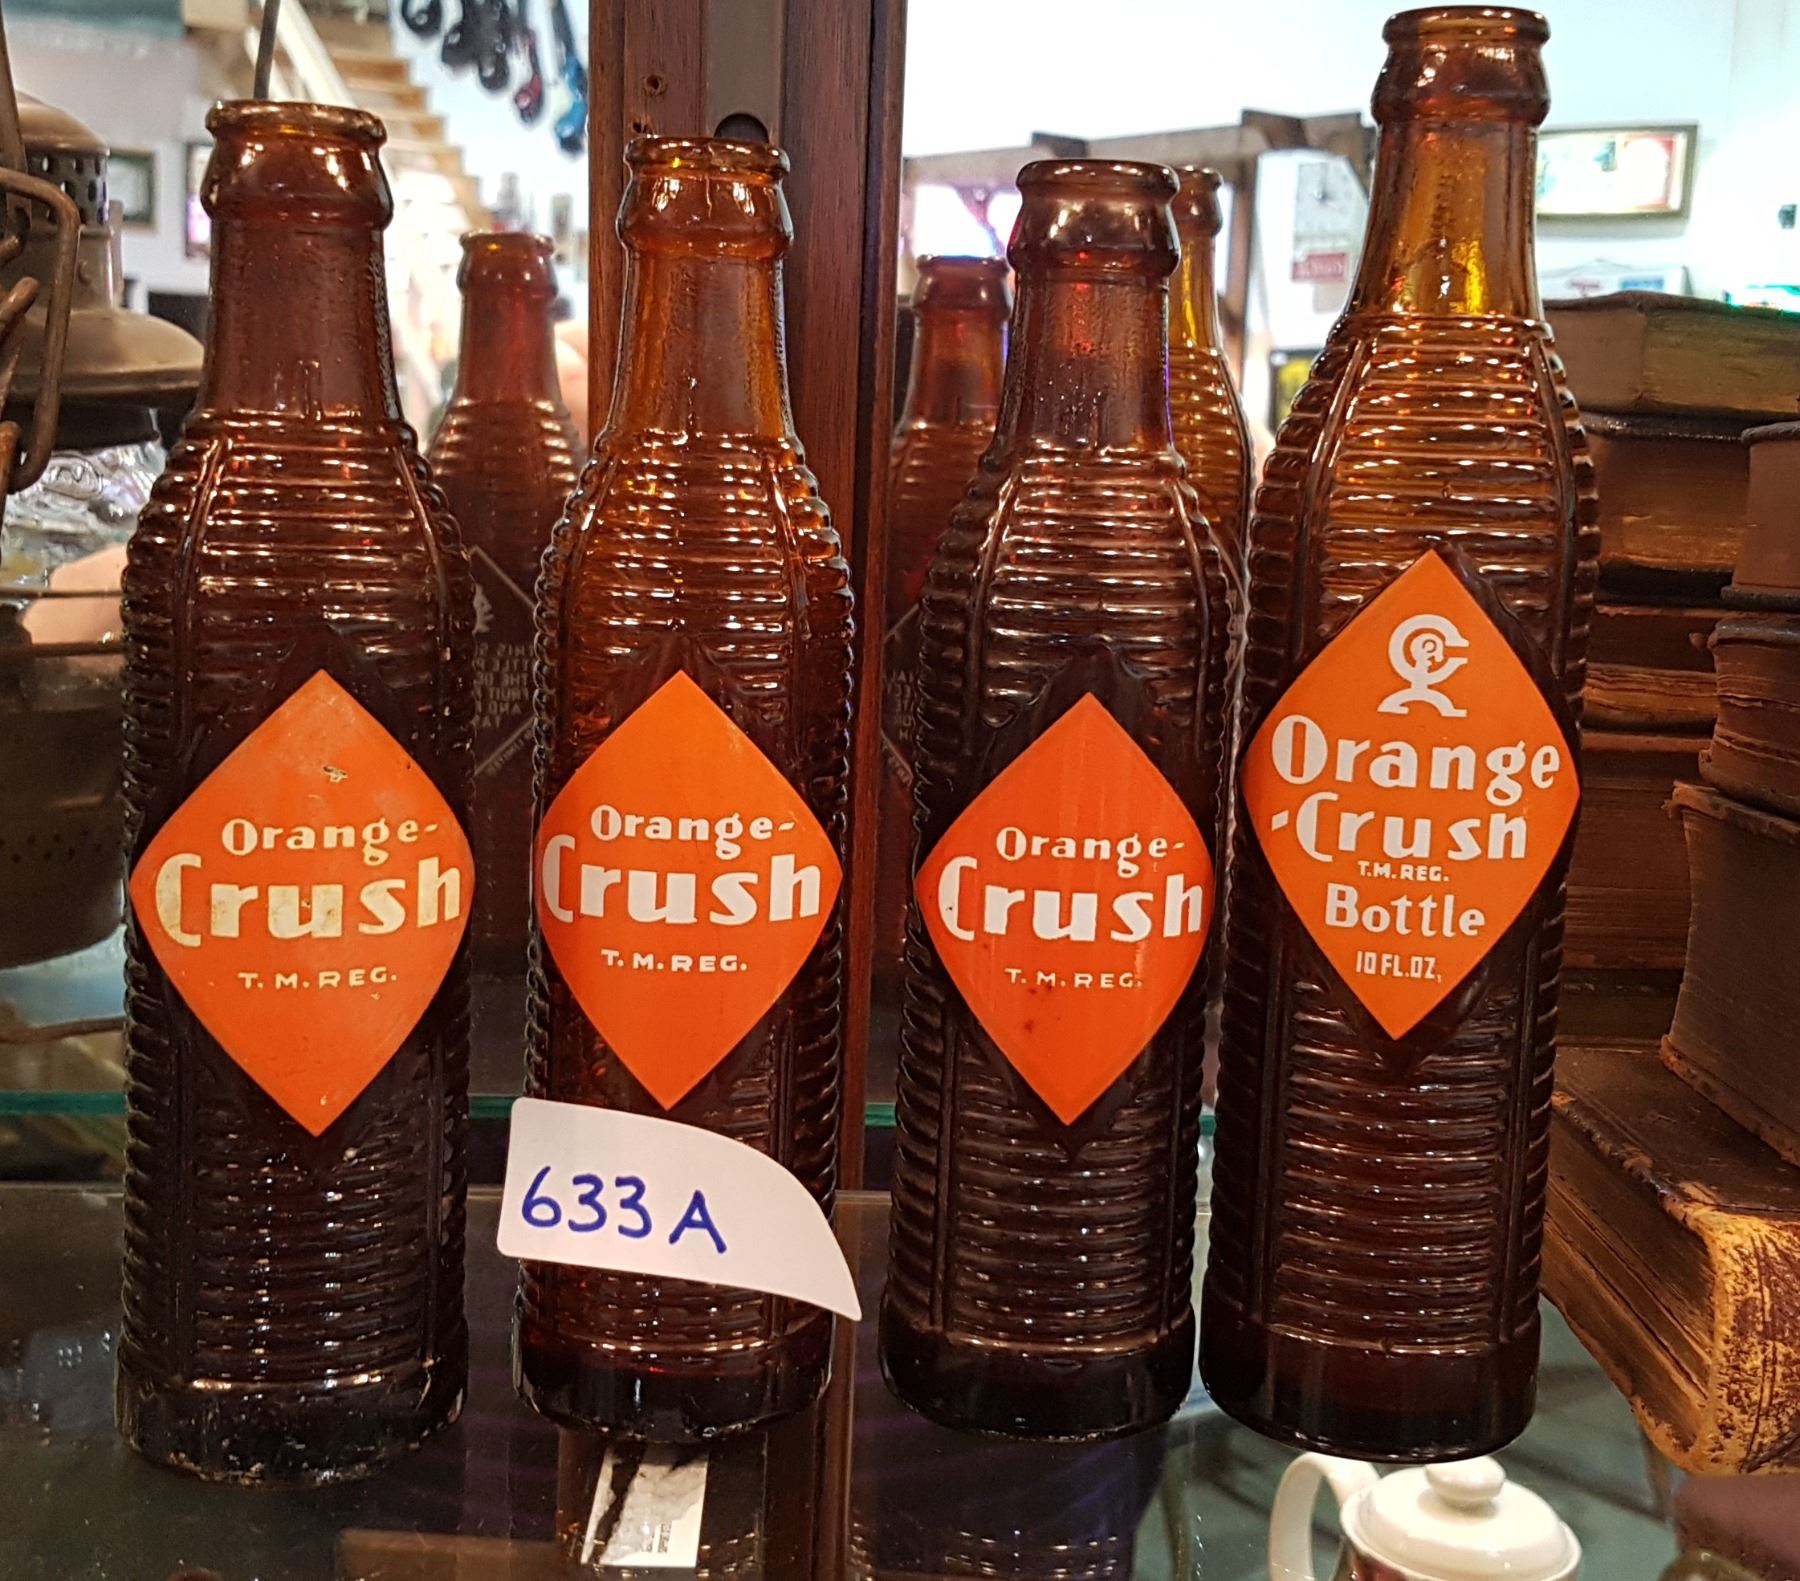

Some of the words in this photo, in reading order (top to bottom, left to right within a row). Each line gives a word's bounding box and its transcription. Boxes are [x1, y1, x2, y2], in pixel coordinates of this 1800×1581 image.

[1272, 715, 1561, 807] Orange
[222, 818, 437, 866] Orange-
[591, 804, 795, 860] Orange-
[996, 826, 1185, 879] Orange-
[155, 853, 461, 947] Crush
[543, 834, 821, 925] Crush
[938, 856, 1203, 943] Crush
[1325, 882, 1485, 938] Bottle
